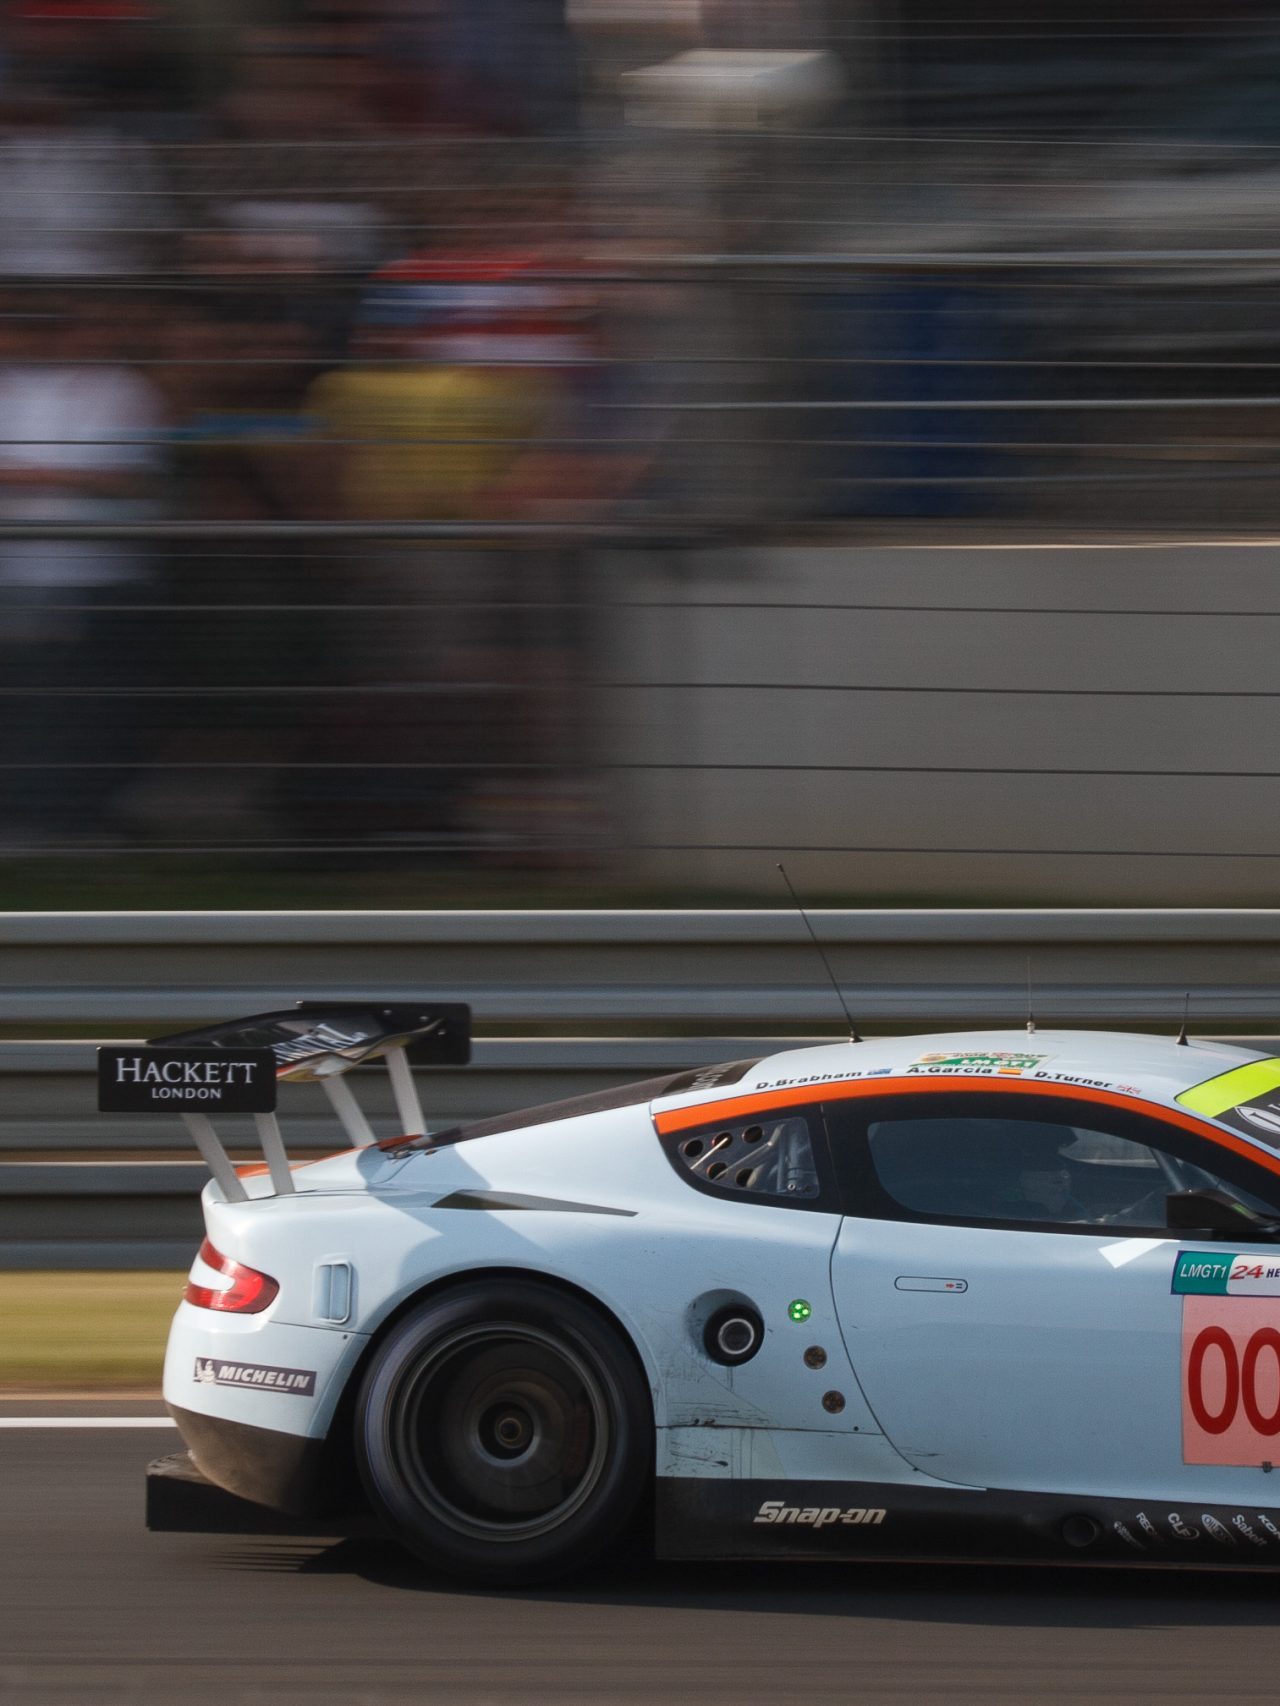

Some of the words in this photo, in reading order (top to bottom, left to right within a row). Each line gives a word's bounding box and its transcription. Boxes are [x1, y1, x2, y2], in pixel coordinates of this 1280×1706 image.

[115, 1057, 258, 1084] HACKETT
[755, 1070, 863, 1090] D.Brabham
[1034, 1070, 1113, 1089] D.Turner
[151, 1087, 222, 1099] LONDON
[1179, 1263, 1228, 1279] LMGT1
[1229, 1264, 1265, 1280] 24
[217, 1364, 310, 1389] MICHELIN
[753, 1500, 887, 1528] Snap-on
